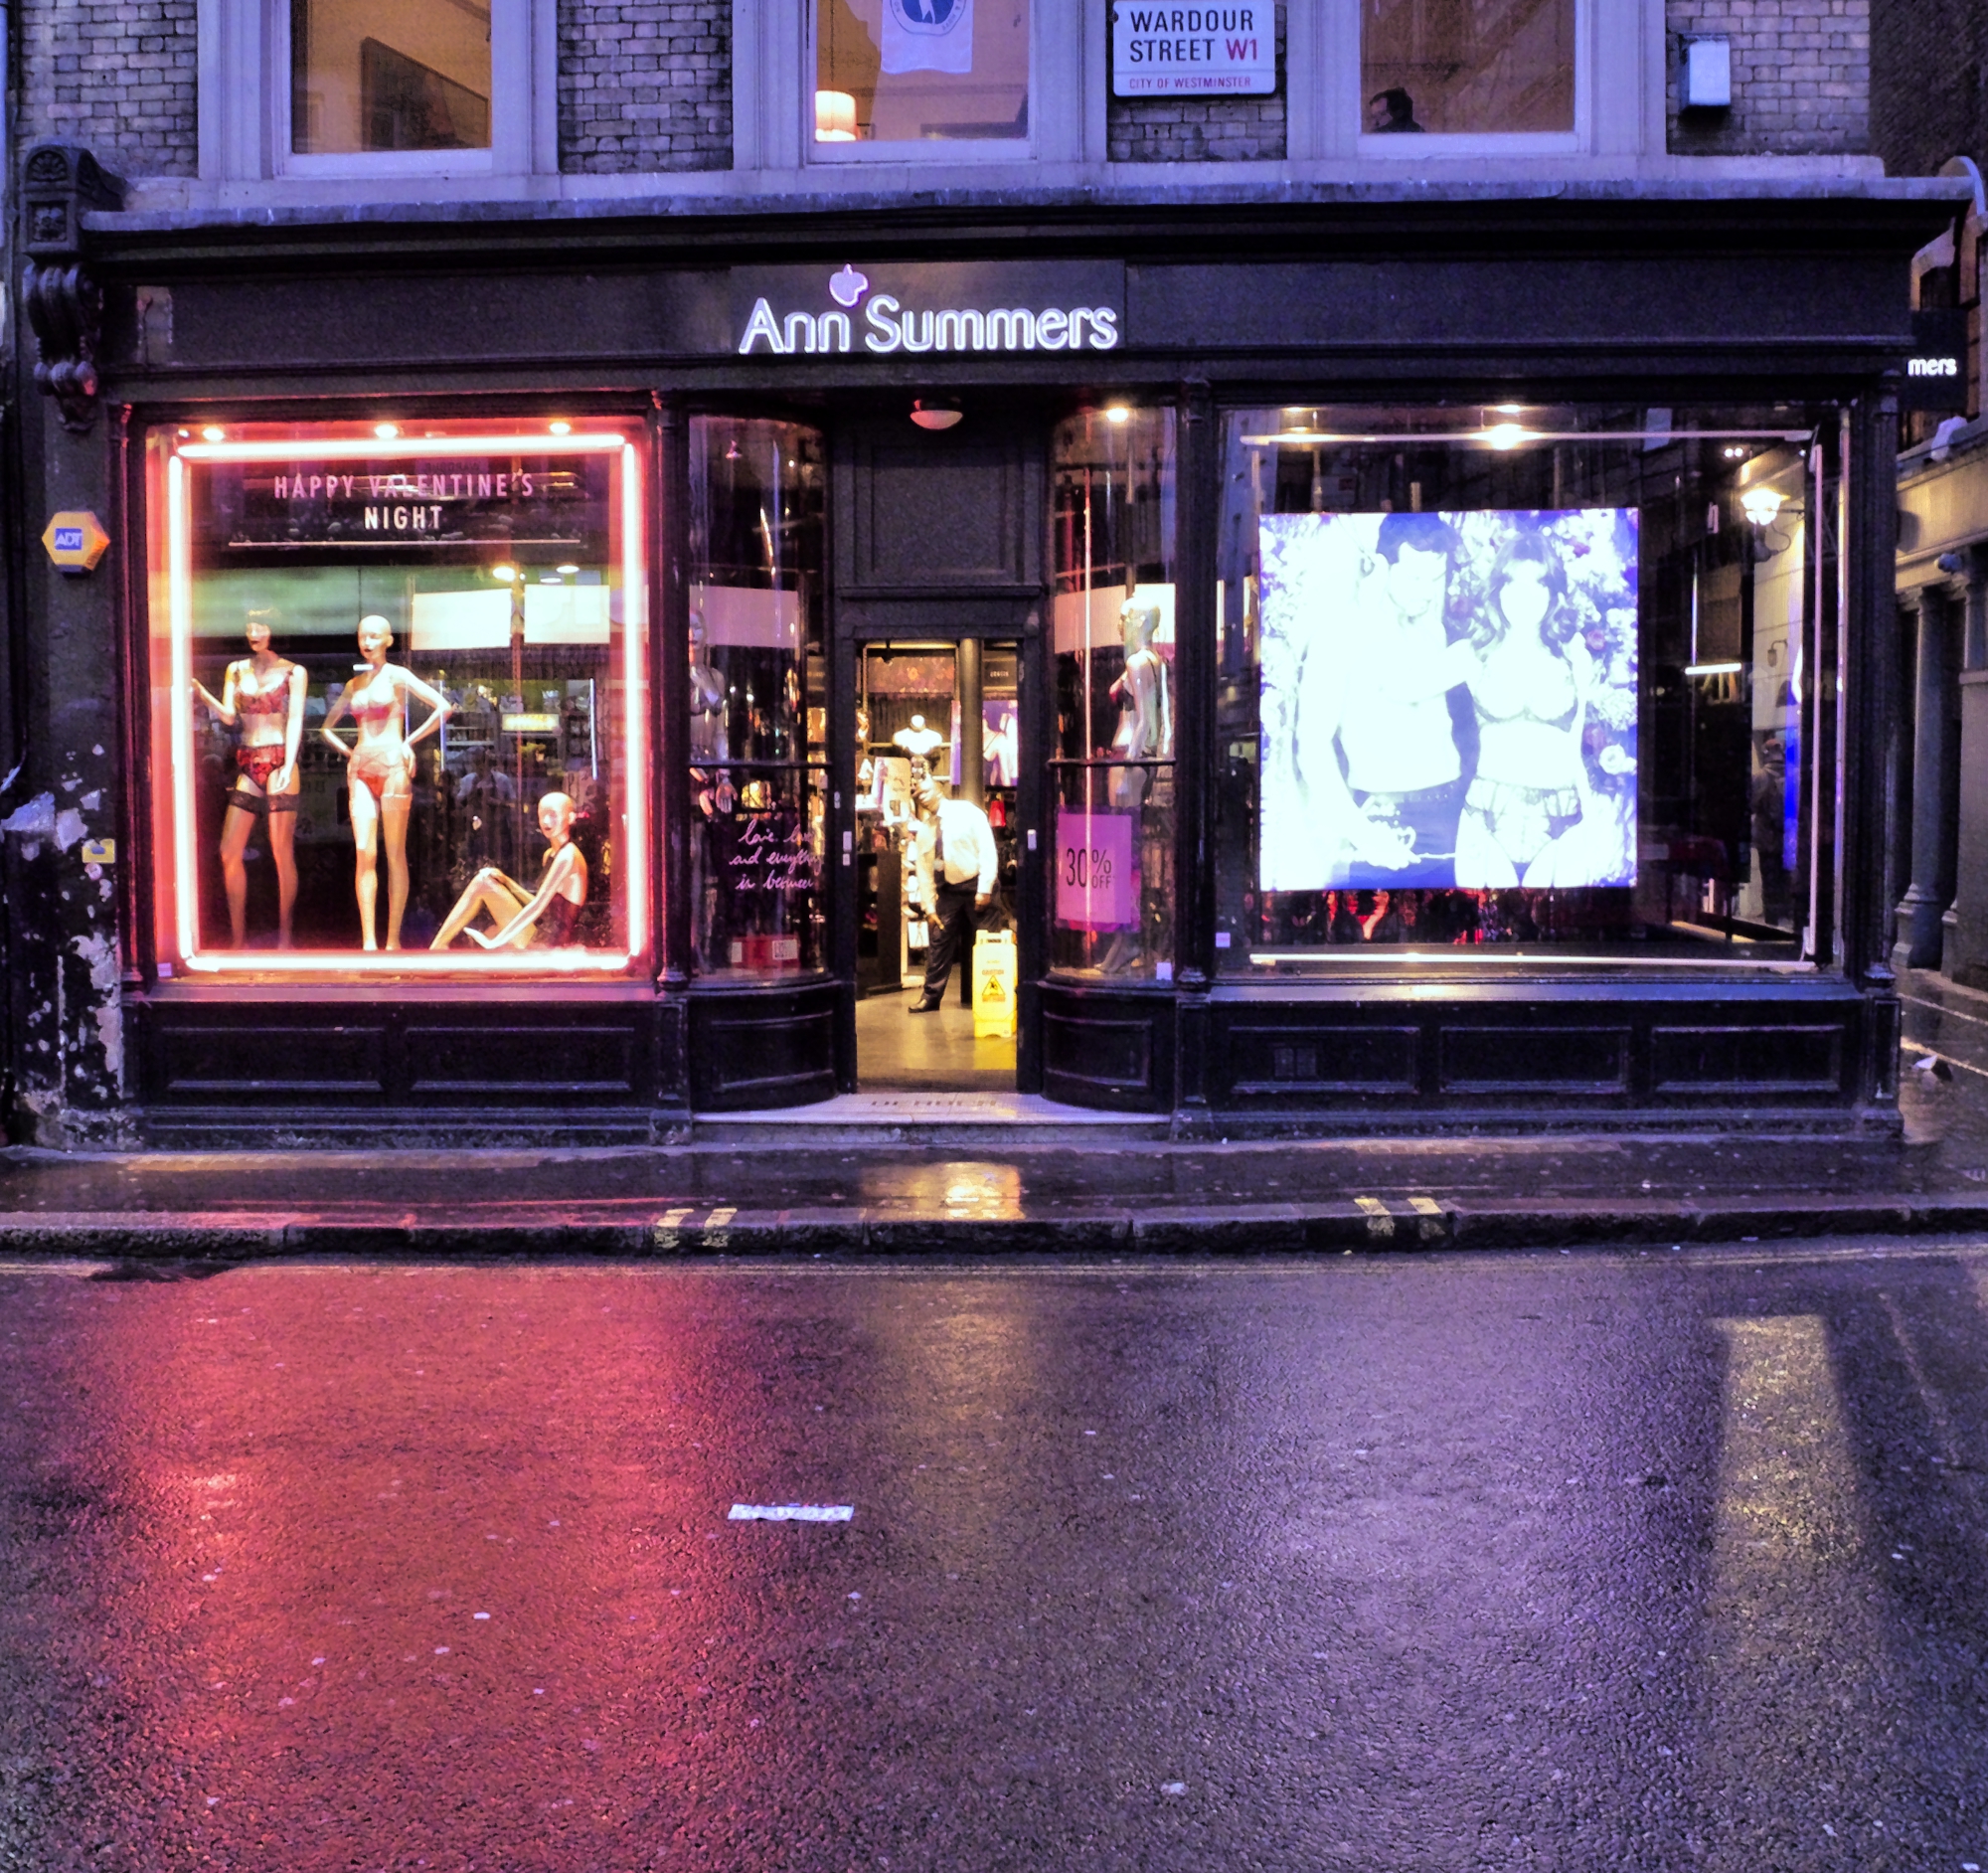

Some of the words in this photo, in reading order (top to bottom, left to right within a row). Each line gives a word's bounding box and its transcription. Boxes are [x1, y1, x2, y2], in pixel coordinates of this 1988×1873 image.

[1130, 10, 1253, 32] WARDOUR
[1129, 39, 1216, 62] STREET
[1226, 38, 1258, 61] W1
[1129, 78, 1152, 89] CITY
[1157, 78, 1169, 88] OF
[1174, 77, 1251, 88] WESTMINSTER
[739, 297, 851, 354] Ann
[864, 294, 1118, 353] Summers
[1907, 358, 1957, 377] mers
[273, 474, 355, 498] HAPPY
[369, 468, 535, 498] VALENTINE'S
[364, 504, 443, 530] NIGHT
[55, 532, 83, 547] ADT
[1066, 847, 1112, 889] 30%
[1090, 875, 1111, 889] OFF
